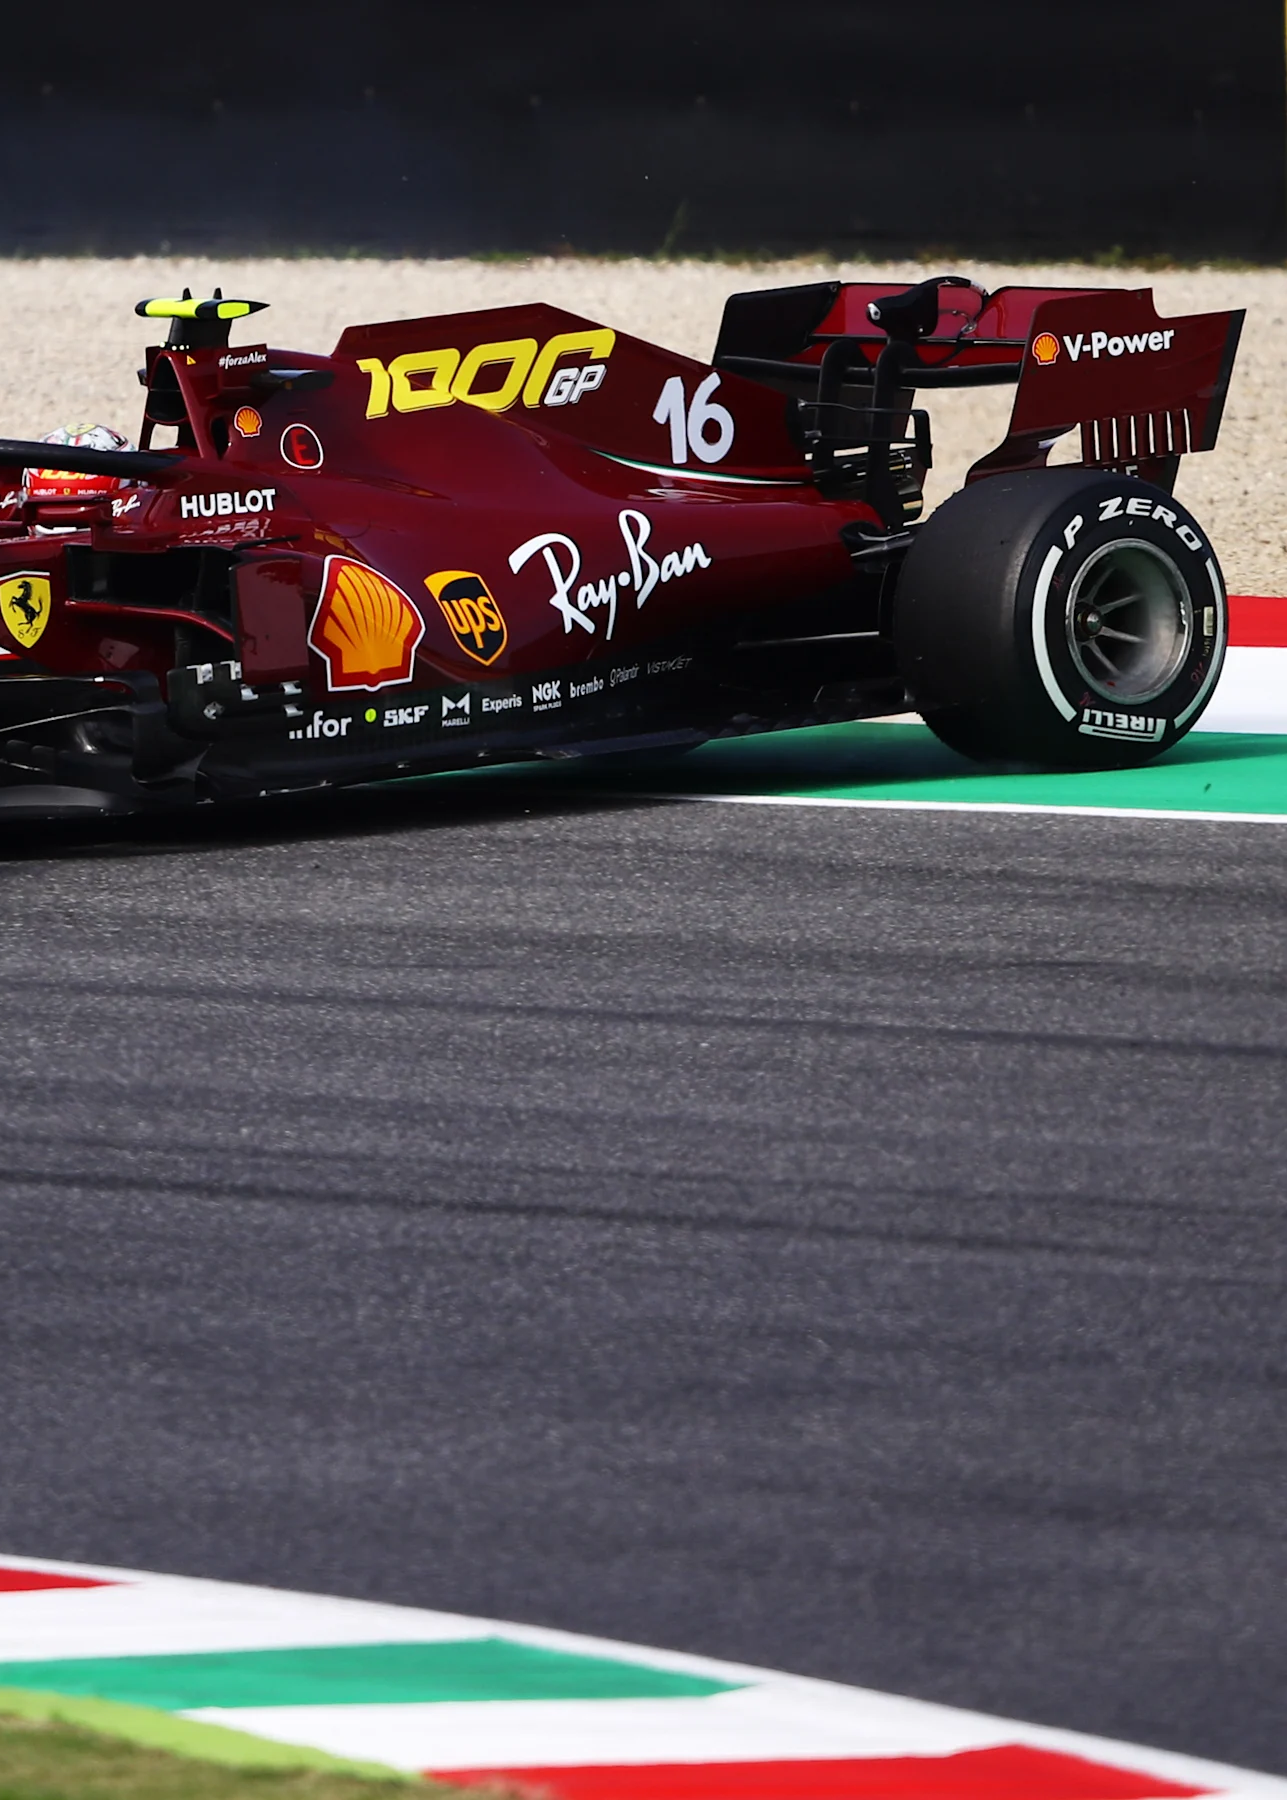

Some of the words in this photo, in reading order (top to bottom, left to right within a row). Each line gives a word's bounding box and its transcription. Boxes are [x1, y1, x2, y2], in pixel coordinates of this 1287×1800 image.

[218, 351, 268, 370] #forzaAlex
[1063, 329, 1175, 362] V-Power
[544, 364, 608, 407] GP
[652, 371, 735, 465] 16
[290, 428, 315, 465] E
[180, 488, 276, 519] HUBLOT
[1063, 514, 1084, 550] P
[1098, 496, 1203, 551] ZERO
[440, 595, 502, 650] ups
[482, 694, 523, 713] Experis
[531, 680, 562, 704] NGK
[569, 676, 605, 699] brembo
[383, 705, 429, 728] SKF
[441, 717, 470, 728] MARELLI
[1078, 708, 1167, 743] PIRELLI
